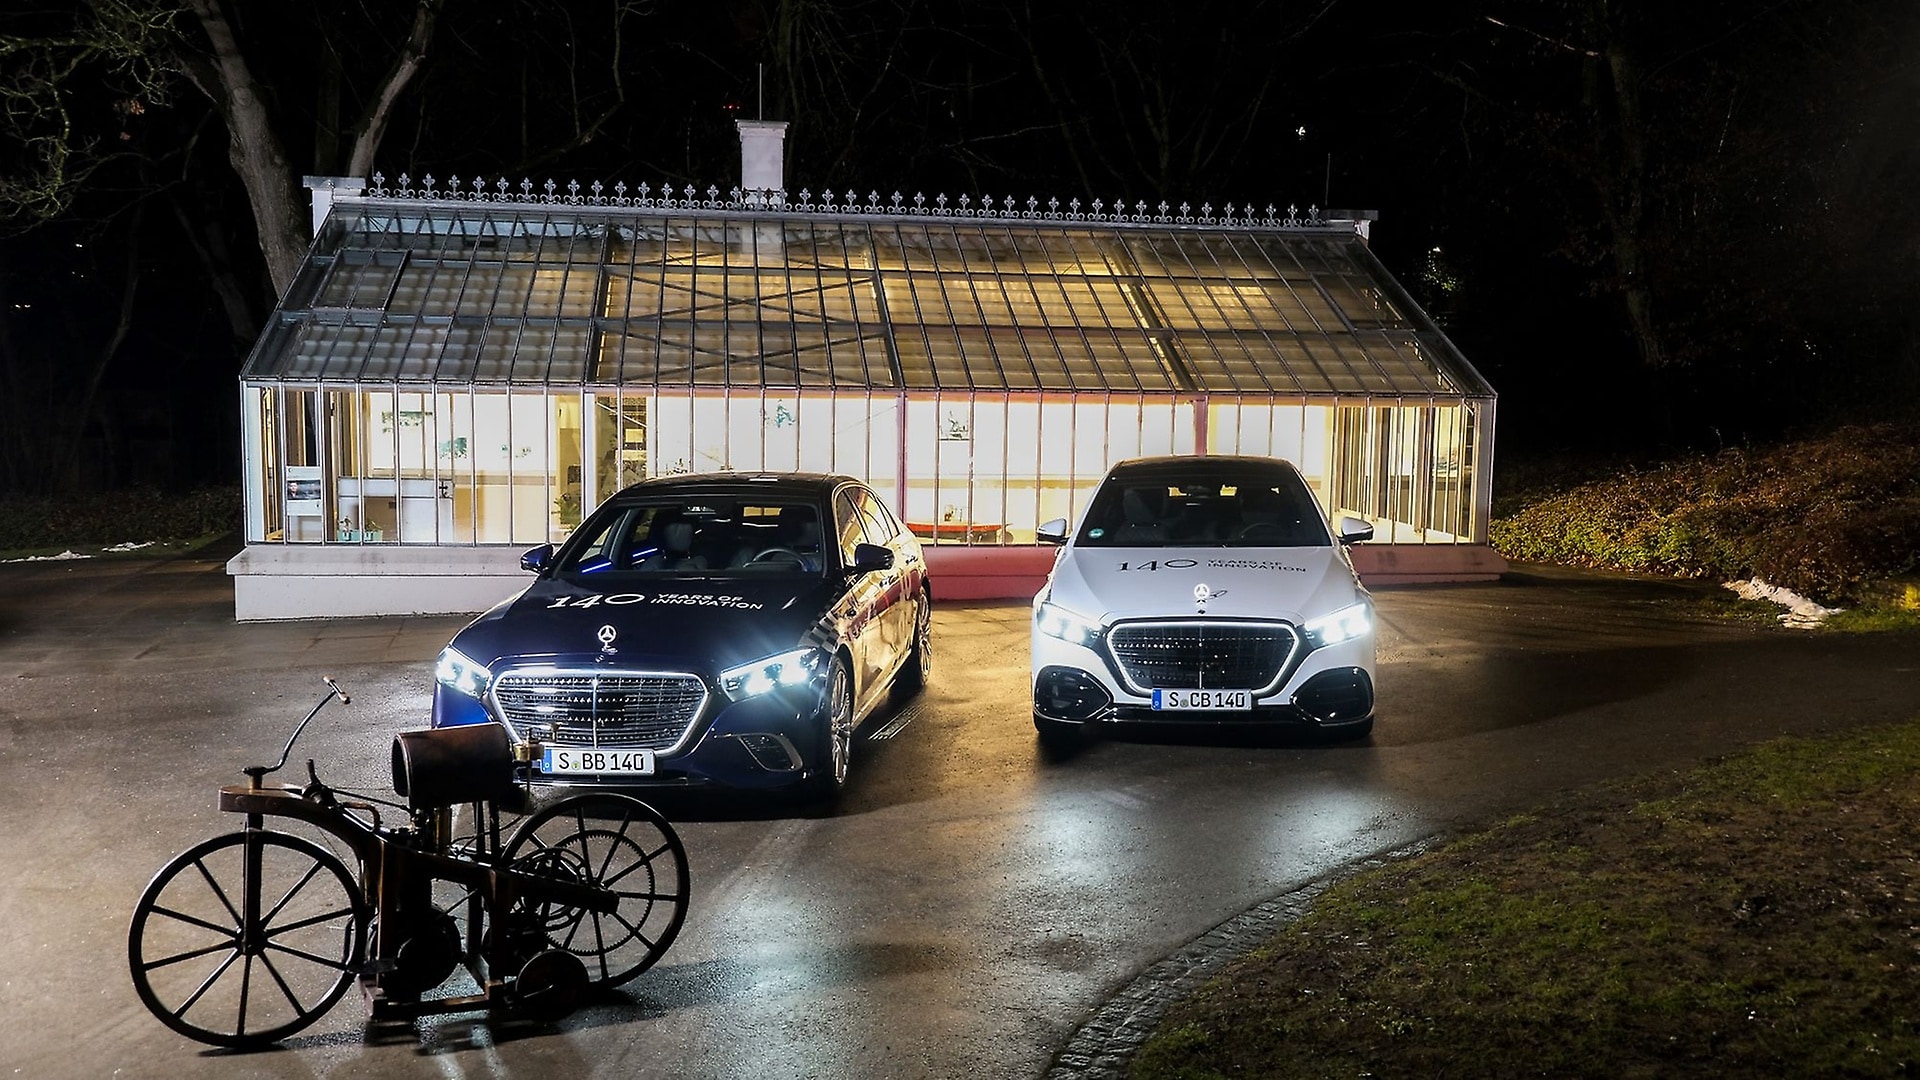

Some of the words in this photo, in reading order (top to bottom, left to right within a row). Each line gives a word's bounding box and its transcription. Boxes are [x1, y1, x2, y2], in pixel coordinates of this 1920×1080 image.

[1116, 558, 1199, 571] 140
[1207, 563, 1306, 573] INNOVATION
[546, 593, 646, 609] 140
[658, 593, 714, 601] YEARS
[650, 598, 764, 610] INNOVATION
[1168, 691, 1179, 708] S
[1189, 692, 1211, 708] CB
[1214, 692, 1246, 708] 140
[559, 752, 570, 770] S
[582, 752, 606, 771] BB
[610, 753, 644, 771] 140
